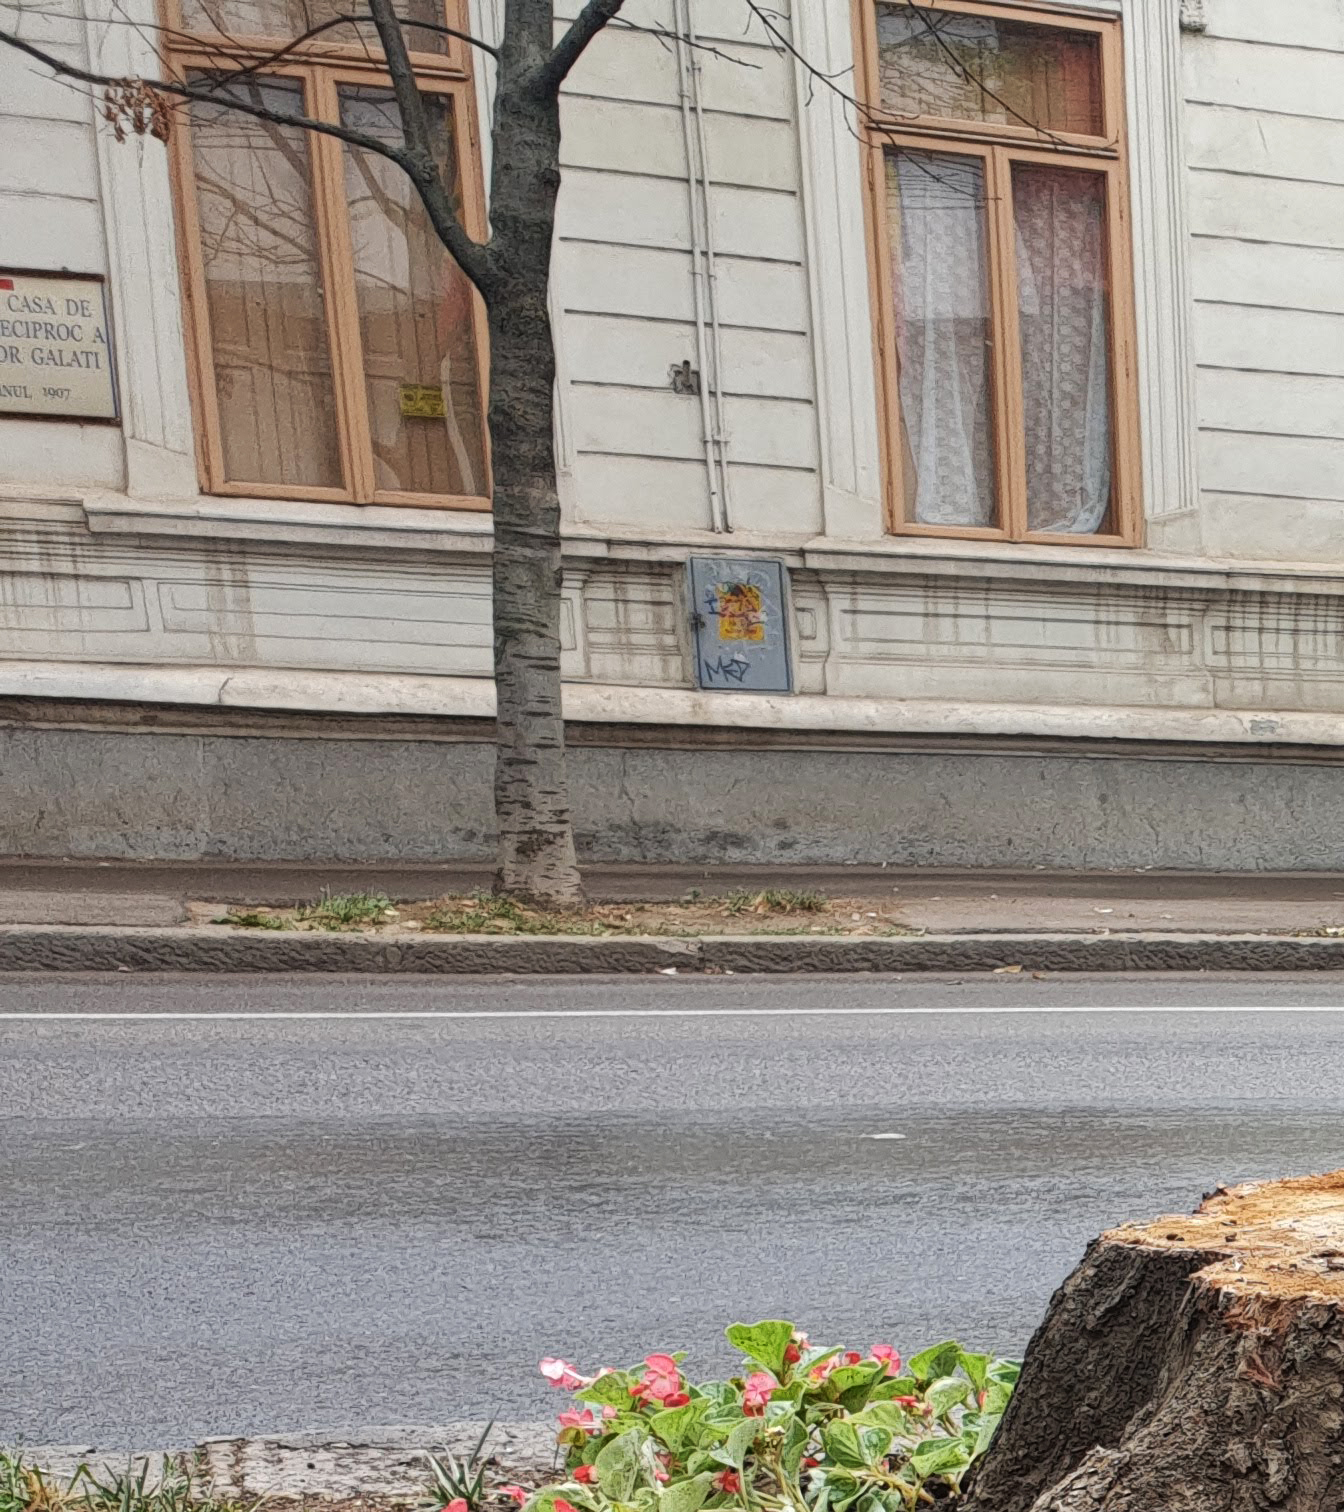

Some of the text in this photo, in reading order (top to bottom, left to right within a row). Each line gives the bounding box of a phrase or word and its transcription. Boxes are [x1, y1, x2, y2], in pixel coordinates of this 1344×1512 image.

[8, 294, 92, 318] CASA DE
[93, 326, 106, 344] A
[0, 385, 71, 399] NUL 1907
